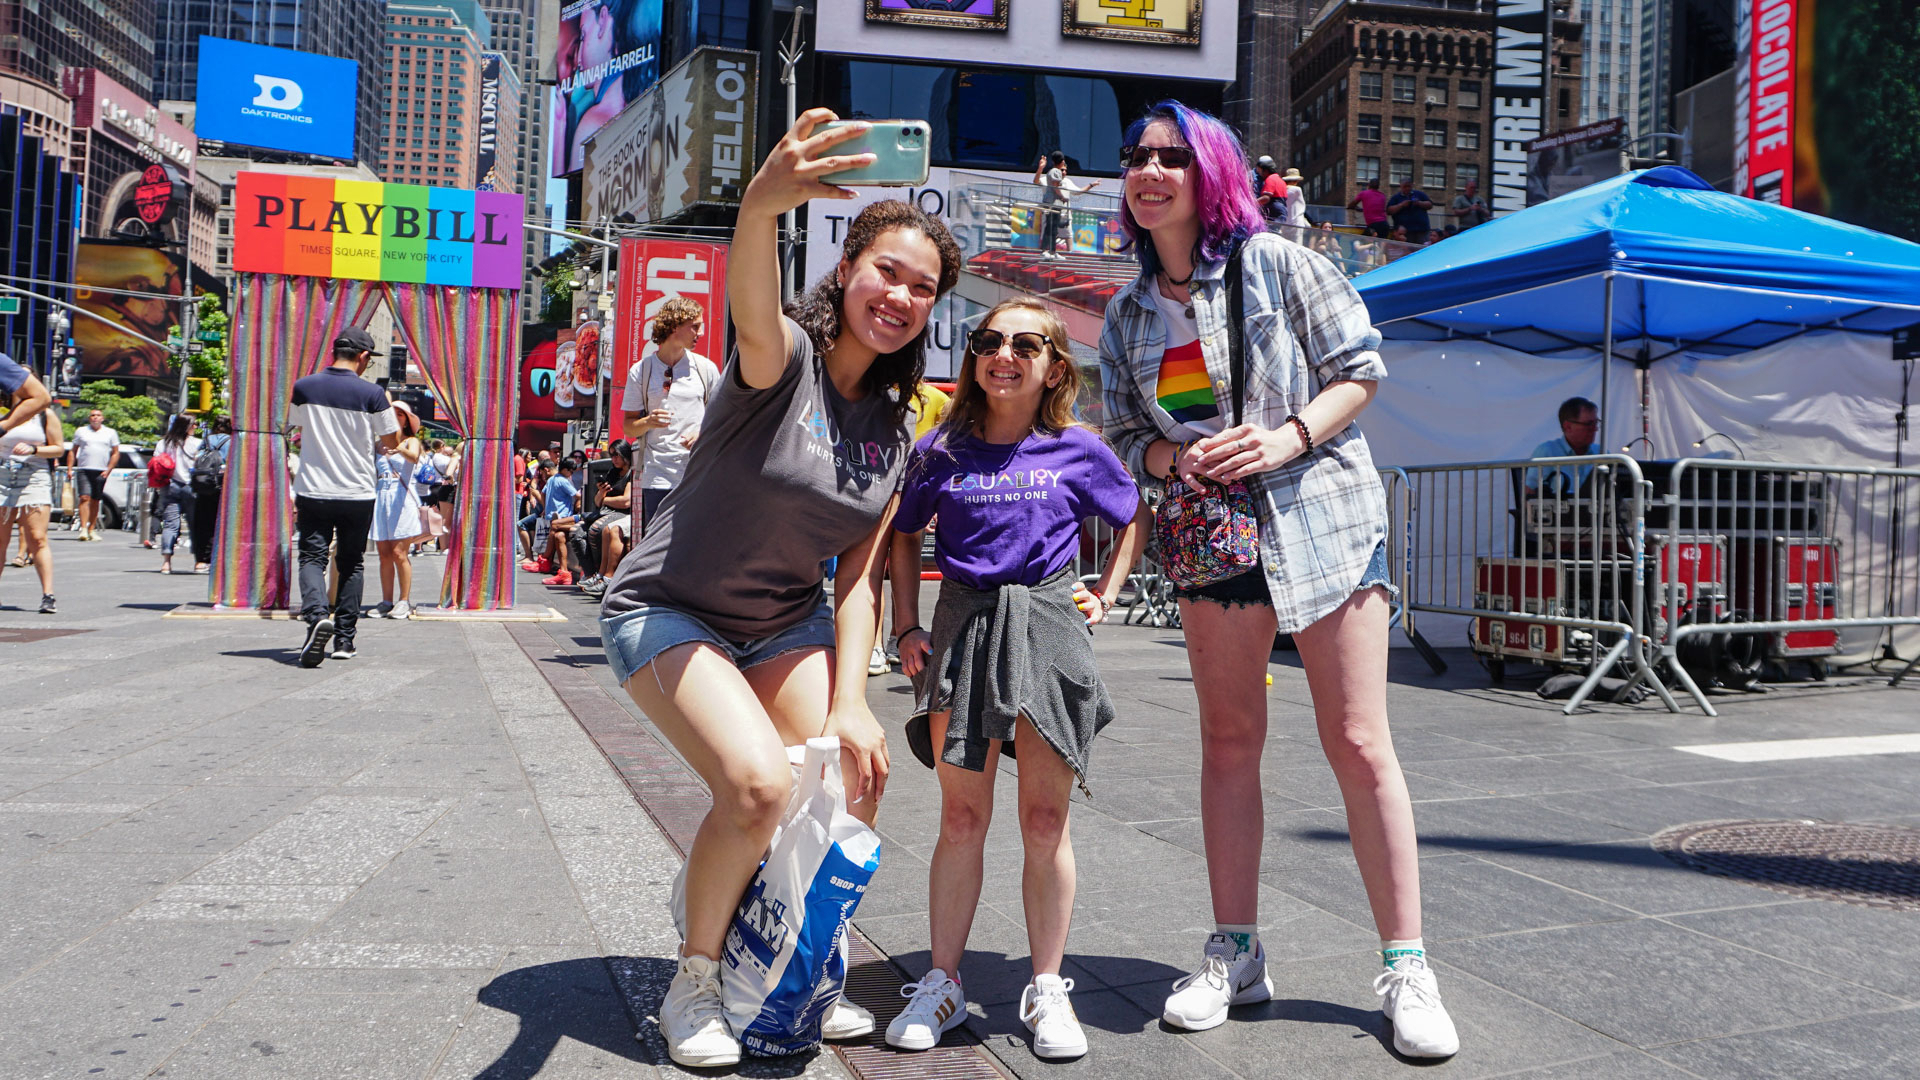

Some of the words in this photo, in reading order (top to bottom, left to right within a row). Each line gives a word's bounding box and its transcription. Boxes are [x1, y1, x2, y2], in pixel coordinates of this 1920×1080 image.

[560, 61, 609, 94] ALANNAH
[609, 43, 655, 75] FARRELL
[1496, 26, 1544, 86] MY
[241, 107, 313, 124] DAKTRONICS
[711, 59, 746, 196] HELLO!
[599, 160, 612, 184] THE
[613, 136, 635, 173] BOOK
[636, 123, 648, 148] OF
[253, 194, 508, 246] PLAYBILL
[300, 244, 331, 256] TIMES
[335, 246, 379, 259] SQUARE,
[383, 250, 407, 261] NEW
[411, 252, 437, 263] YORK
[440, 254, 463, 265] CITY
[634, 294, 642, 320] Theatre
[632, 319, 641, 362] Development
[797, 400, 891, 470] EQULITY
[807, 441, 842, 468] HURTS
[846, 462, 856, 477] NO
[859, 471, 881, 485] ONE
[965, 493, 1001, 504] HURTS
[1005, 492, 1021, 502] NO
[1025, 490, 1048, 500] ONE
[1509, 632, 1526, 645] 964
[830, 875, 855, 890] SHOP
[746, 1036, 762, 1049] ON
